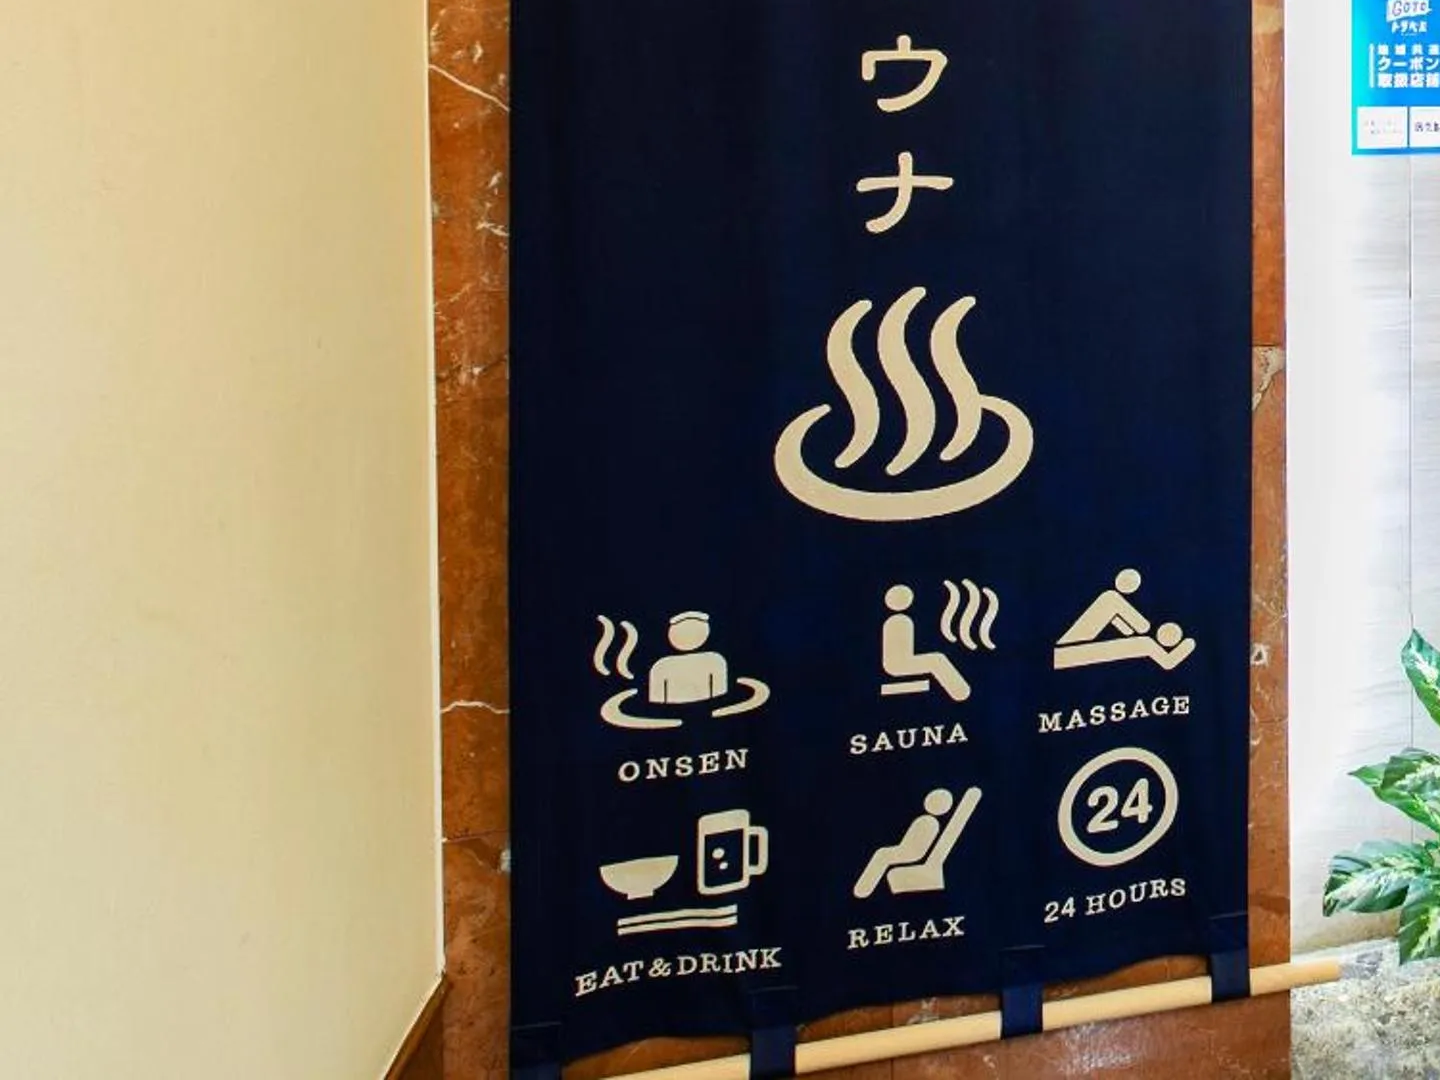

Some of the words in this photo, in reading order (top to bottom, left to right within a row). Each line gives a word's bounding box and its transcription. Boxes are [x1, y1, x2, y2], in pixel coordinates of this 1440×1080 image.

[1377, 57, 1440, 71] クーポン
[1039, 695, 1190, 732] MASSAGE
[851, 723, 968, 754] SAUNA
[619, 749, 748, 781] ONSEN
[1086, 777, 1153, 834] 24
[1045, 896, 1075, 922] 24
[1086, 879, 1186, 917] HOURS
[847, 916, 964, 948] RELAX
